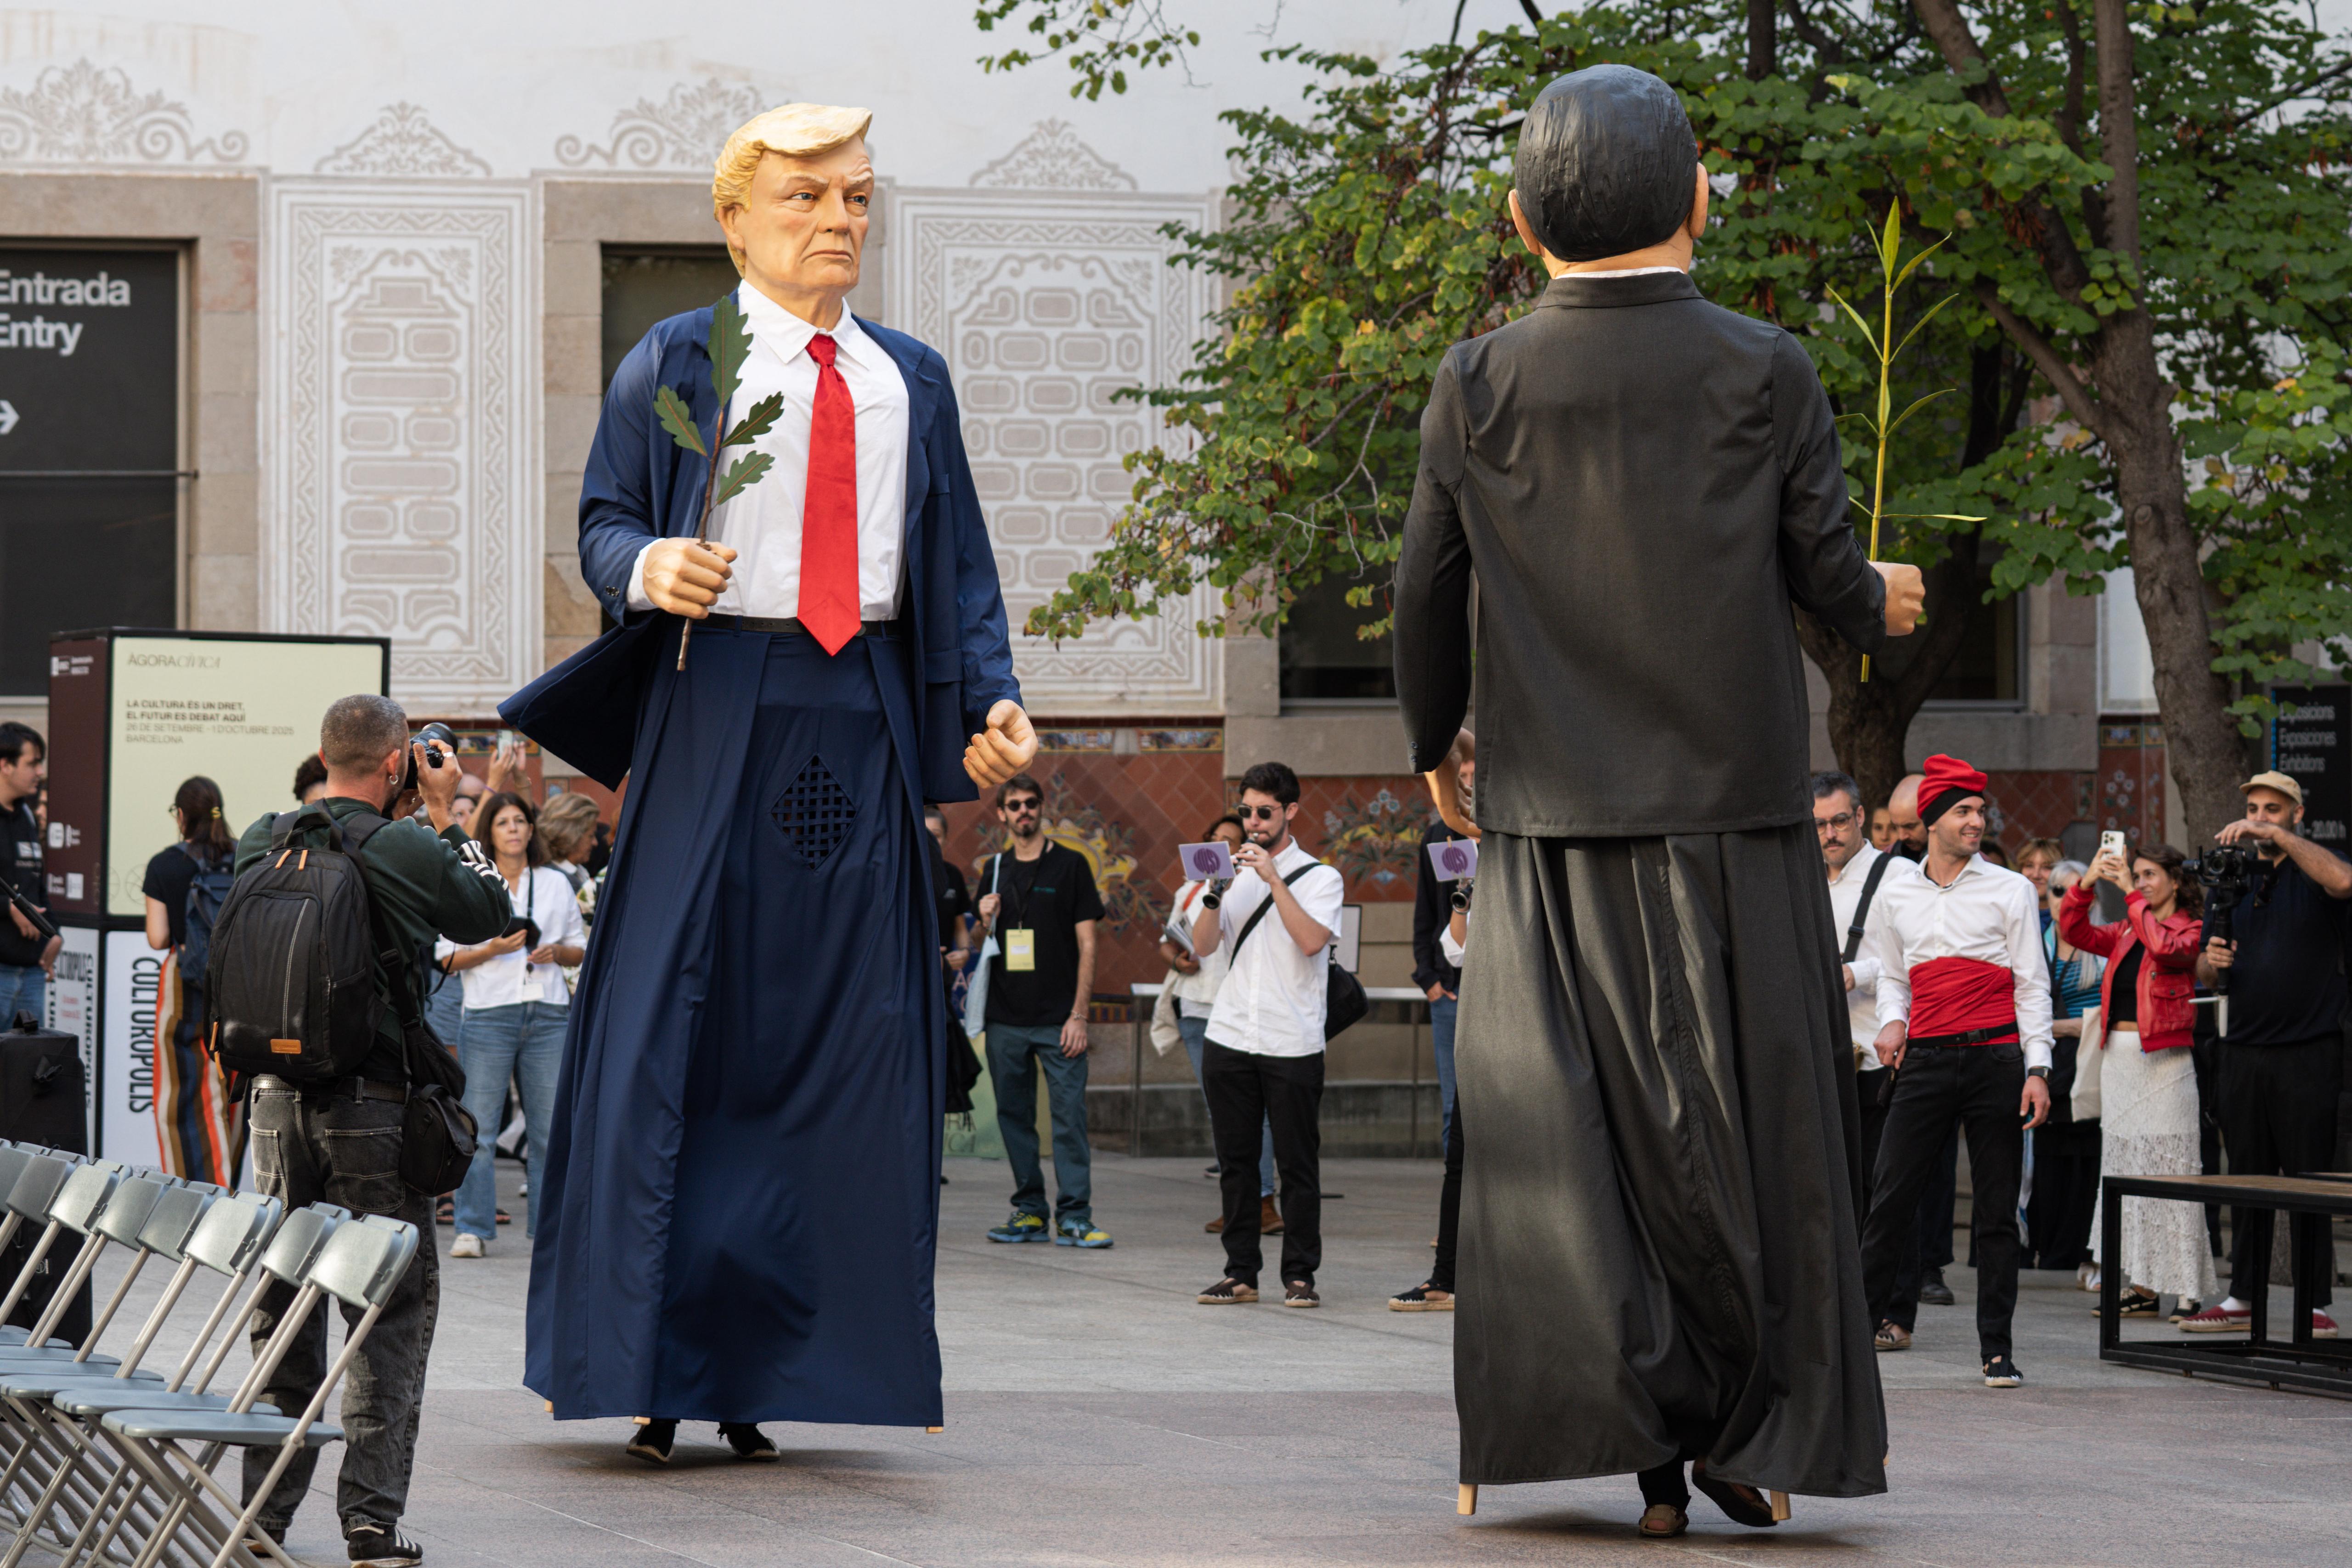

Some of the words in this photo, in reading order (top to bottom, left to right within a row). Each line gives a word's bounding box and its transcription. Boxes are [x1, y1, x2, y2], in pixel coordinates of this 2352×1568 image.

[141, 700, 185, 708] CULTURA
[141, 711, 172, 720] FUTUR
[190, 713, 220, 721] DEBAT
[2279, 701, 2335, 724] Eposicions
[154, 723, 204, 733] SETEMBRE
[272, 726, 294, 735] 2025
[126, 735, 184, 744] BARCELONA
[129, 957, 161, 1113] CULTUROPOLIS
